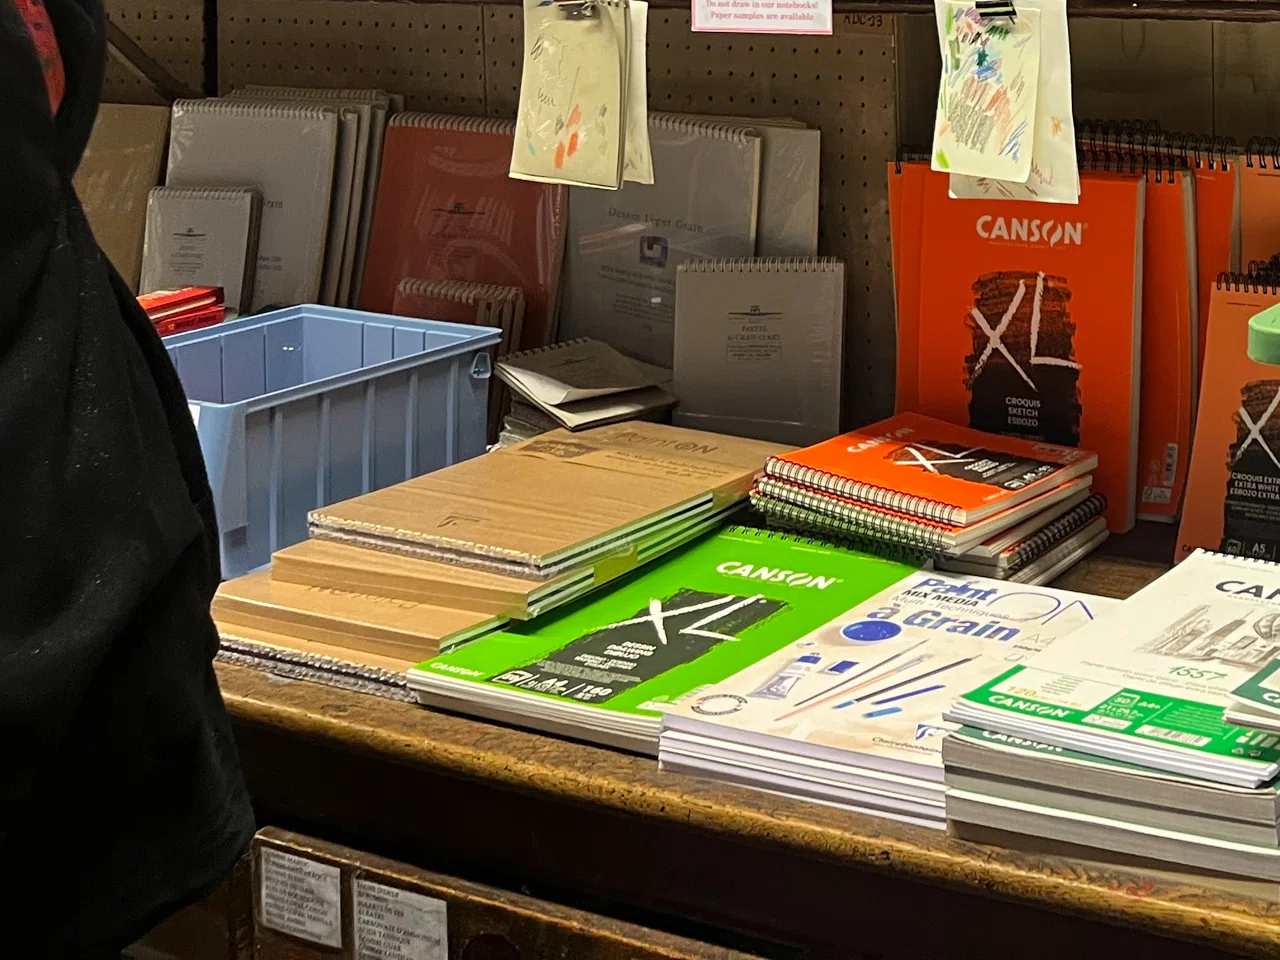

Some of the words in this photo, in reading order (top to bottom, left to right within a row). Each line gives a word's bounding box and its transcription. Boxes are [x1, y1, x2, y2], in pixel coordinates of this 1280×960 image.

[706, 0, 716, 8] Do
[731, 0, 750, 8] draw
[751, 0, 759, 8] in
[776, 0, 818, 9] notebooks!
[710, 12, 732, 21] Paper
[733, 12, 762, 21] samples
[779, 12, 814, 21] available
[976, 215, 1083, 248] CANSON
[967, 271, 1084, 392] XL
[1005, 396, 1041, 408] CROQUIS
[1008, 406, 1038, 417] SKETCH
[1007, 416, 1038, 427] ESBOZO
[1231, 472, 1263, 483] CROQUIS
[1234, 480, 1257, 490] EXTRA
[1257, 483, 1280, 493] WHITE
[1229, 488, 1257, 498] ESBOZO
[1258, 491, 1280, 500] EXTRA
[1252, 542, 1266, 553] A5
[716, 561, 837, 589] CANSON
[901, 589, 932, 599] MIX
[933, 593, 979, 607] MEDIA
[599, 593, 767, 646] XL
[902, 609, 1021, 642] Grain
[1021, 634, 1057, 646] A4
[1168, 665, 1229, 681] 1557
[988, 695, 1069, 719] CANSON
[872, 736, 942, 755] Clairefontain
